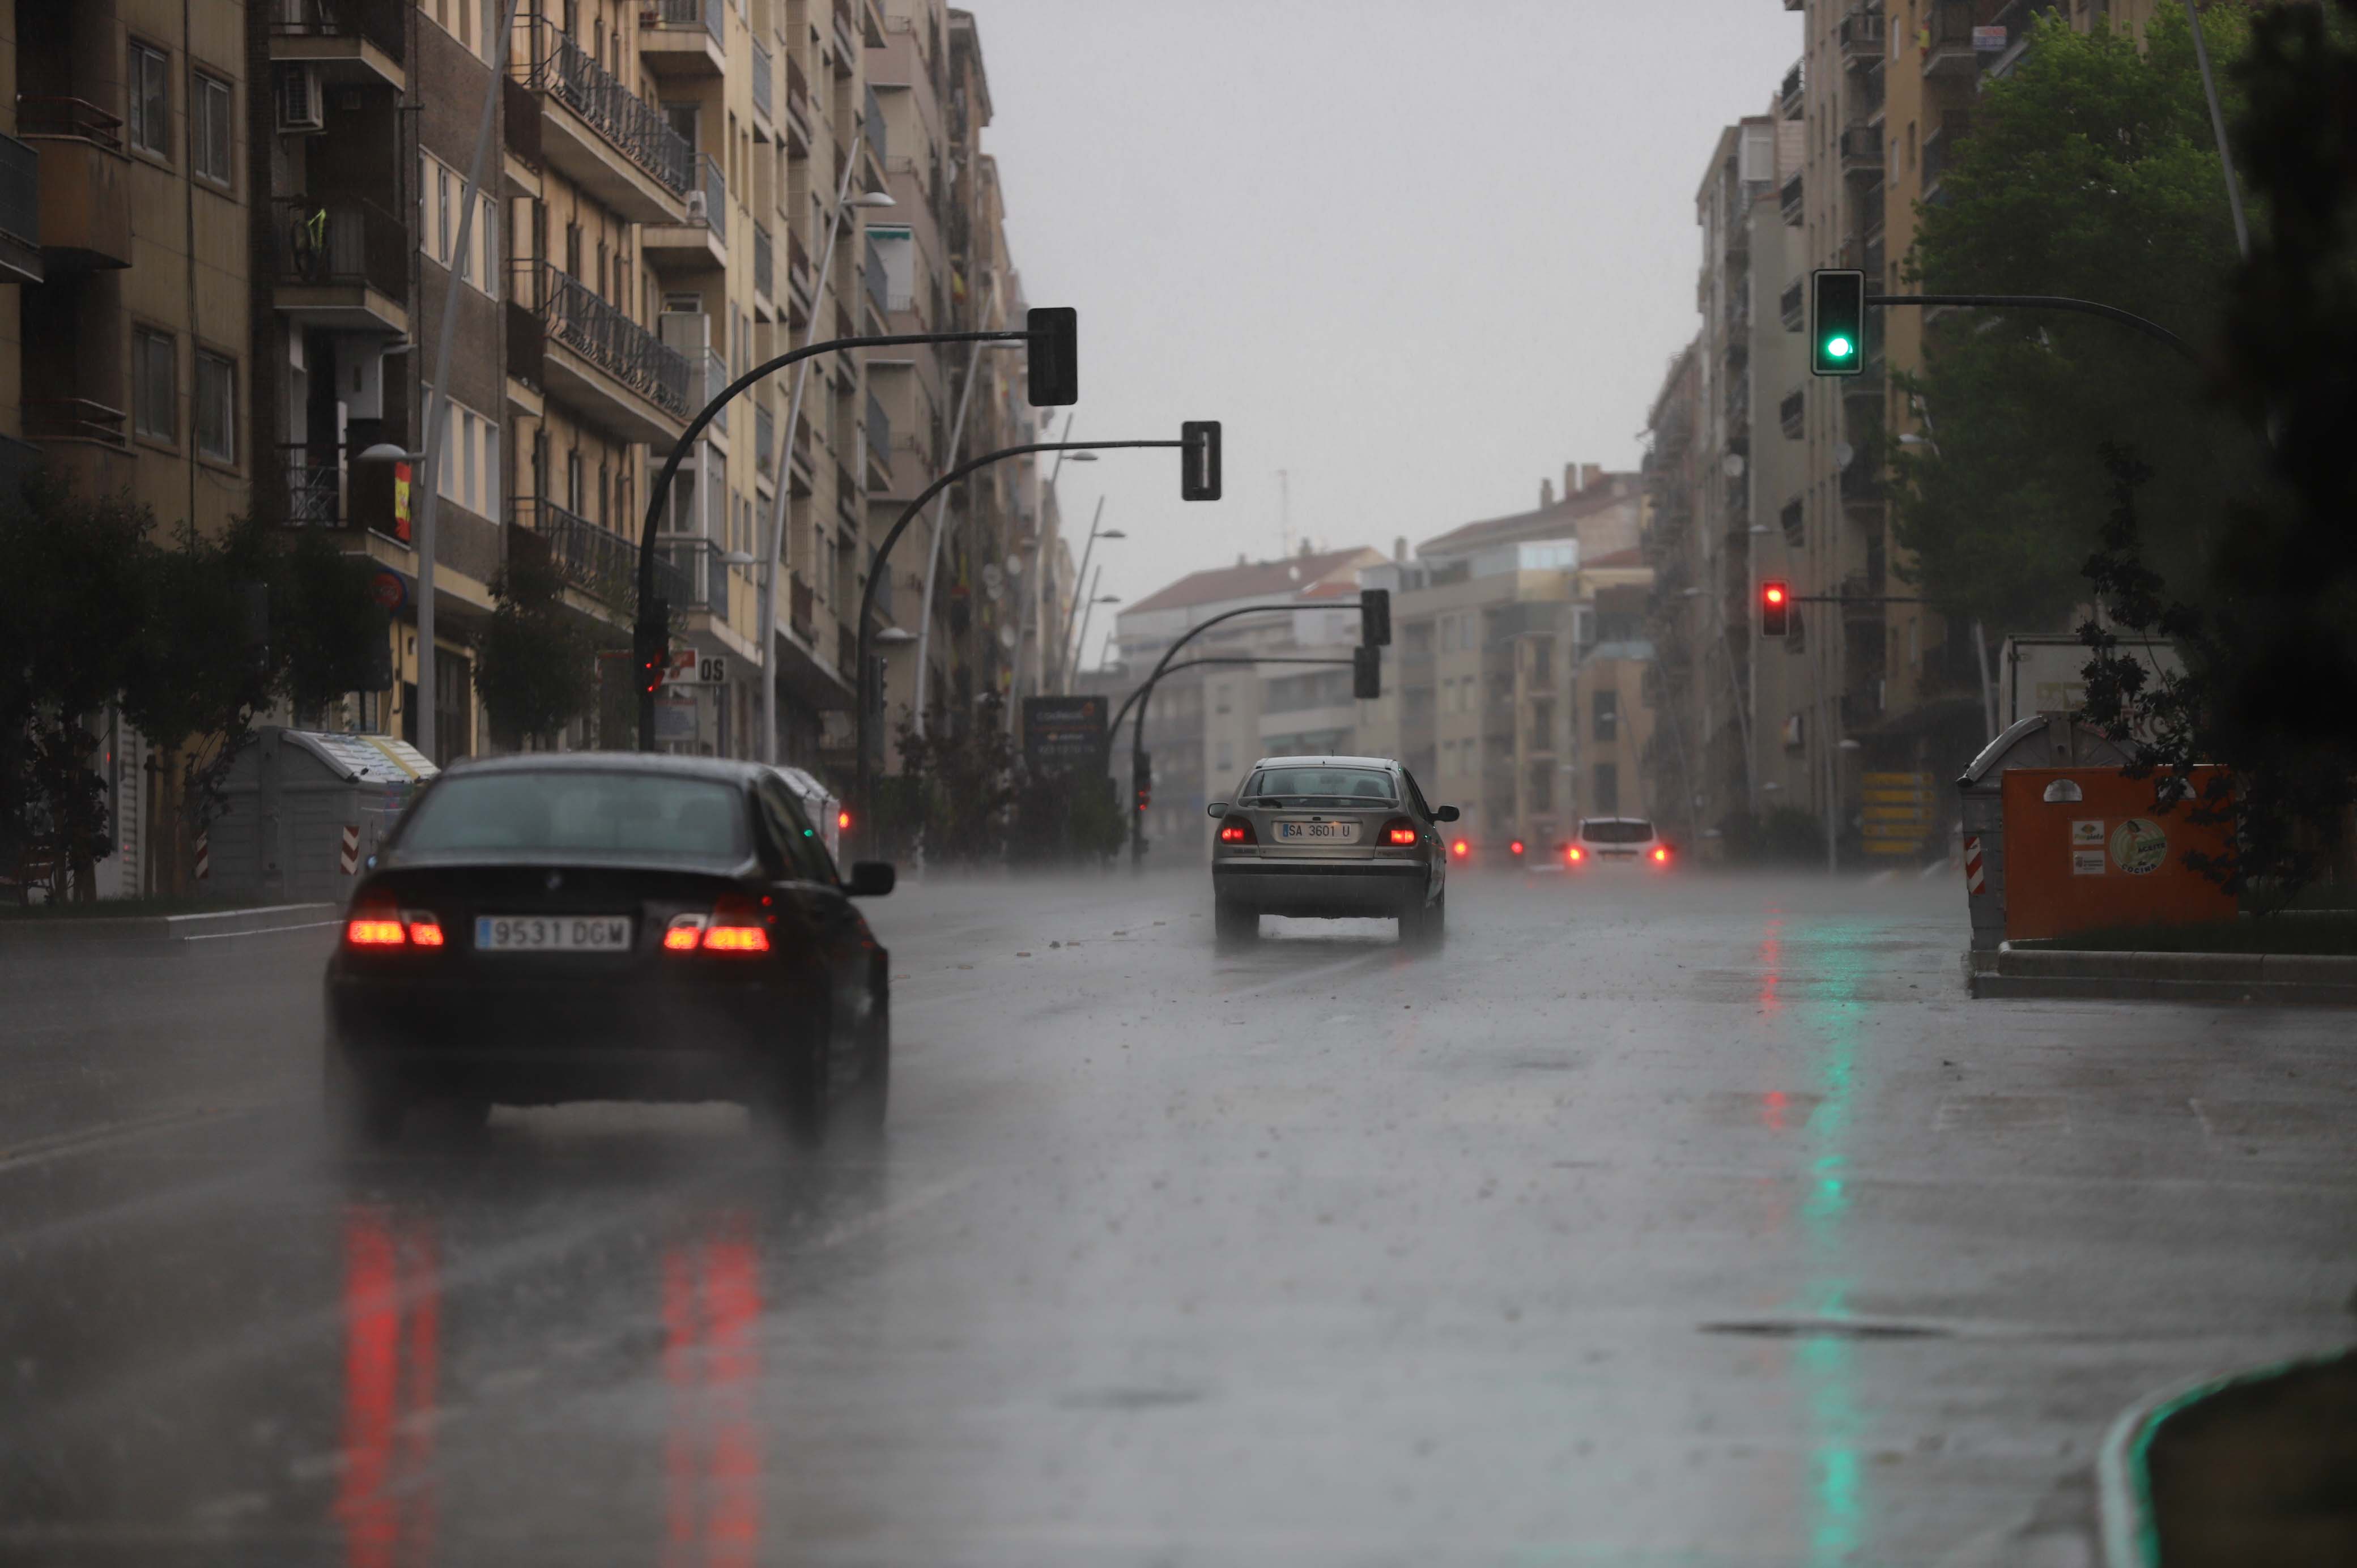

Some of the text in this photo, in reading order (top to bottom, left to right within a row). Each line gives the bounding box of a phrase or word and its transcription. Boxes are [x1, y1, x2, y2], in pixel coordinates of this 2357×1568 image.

[1289, 825, 1350, 837] SA 3601 U
[2138, 842, 2166, 853] ACEITE
[2121, 863, 2157, 874] COCINA
[495, 921, 561, 944] 9531
